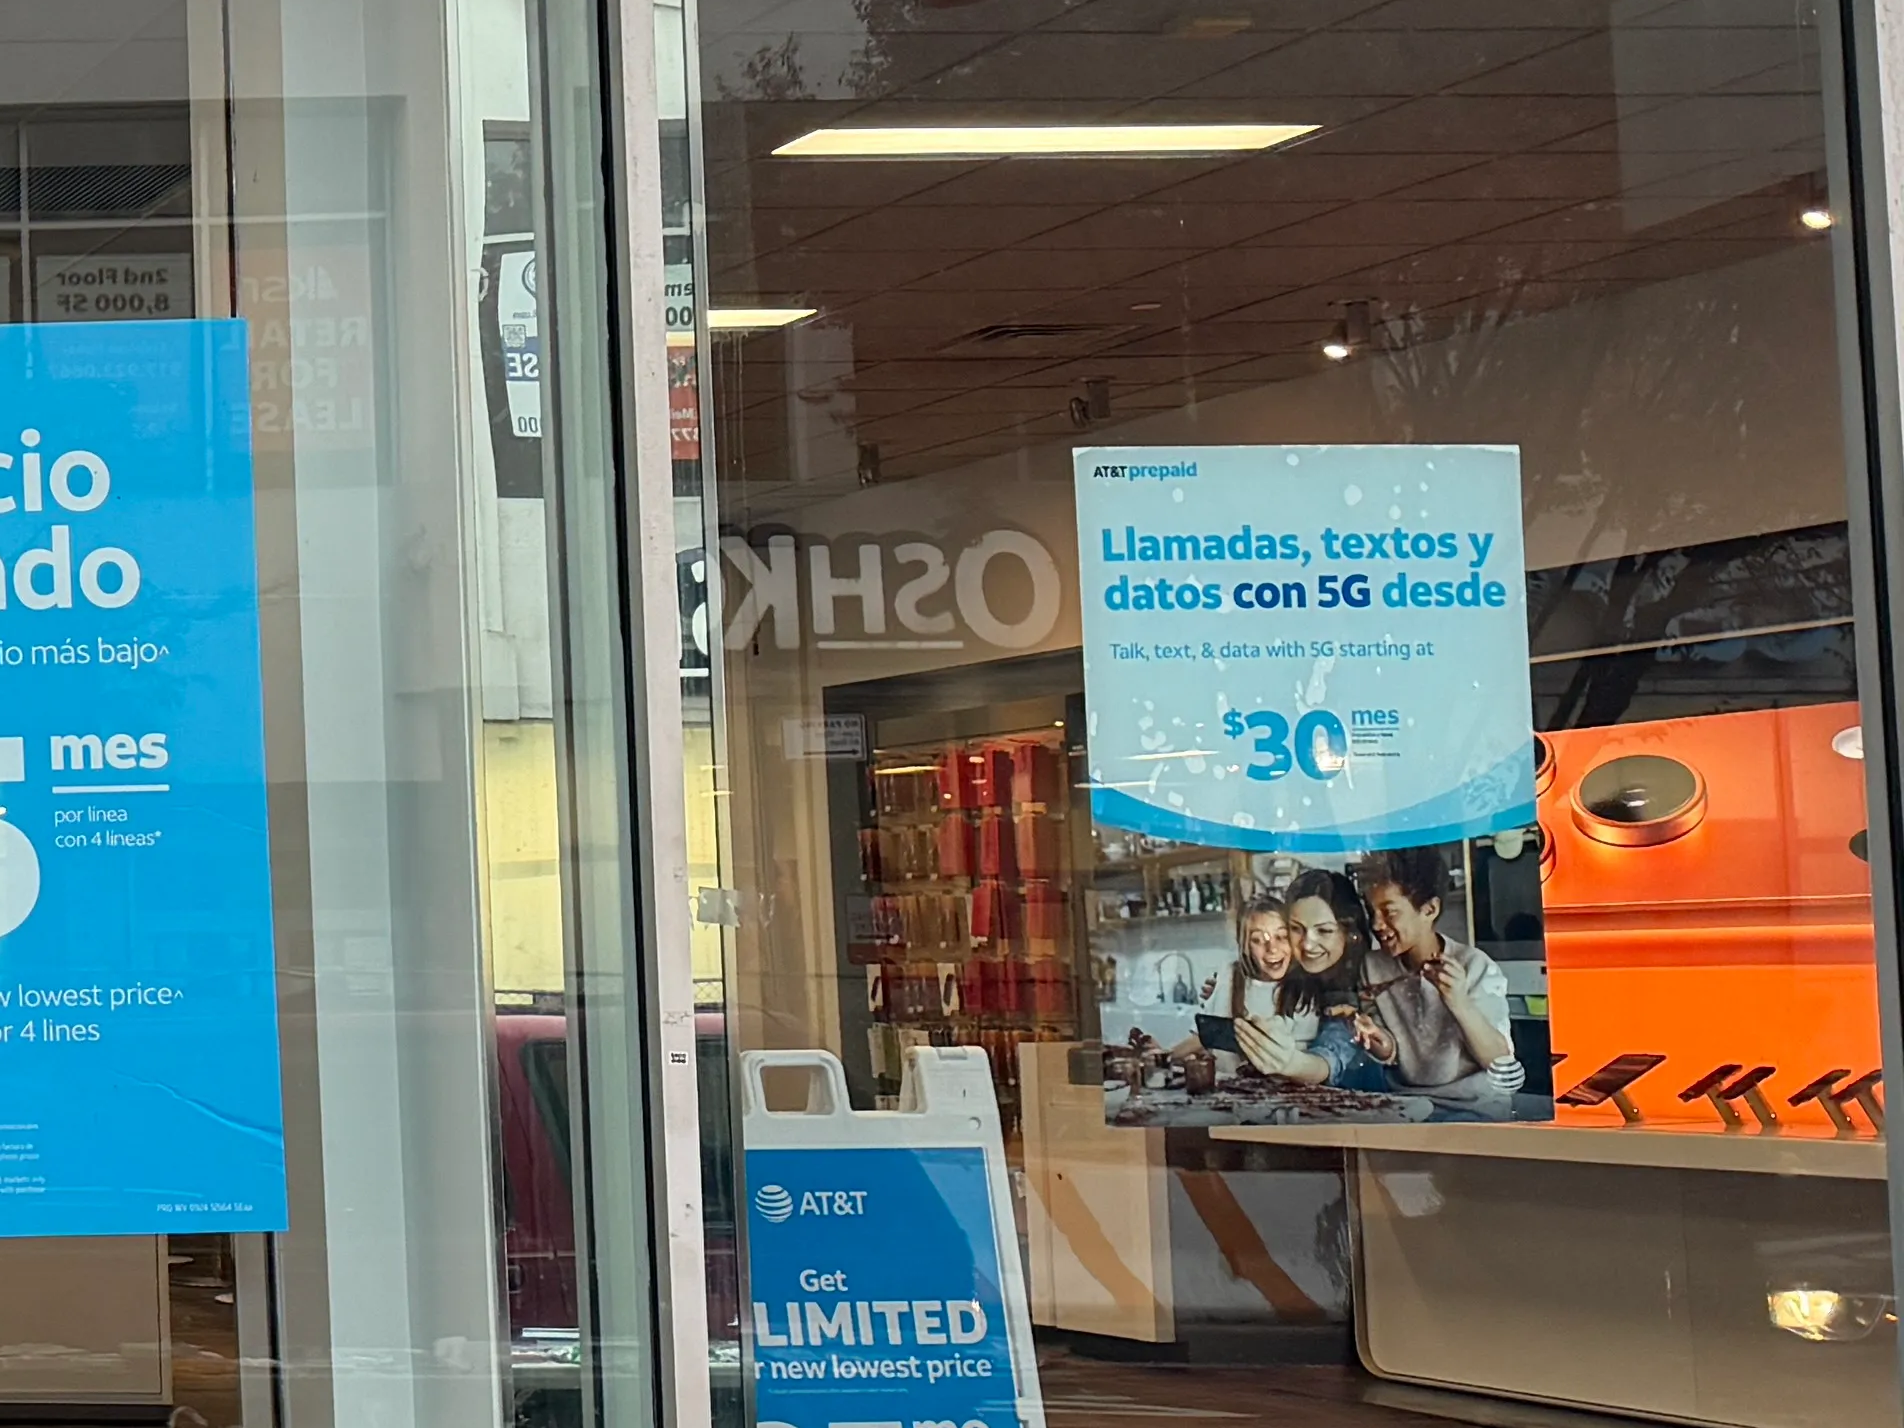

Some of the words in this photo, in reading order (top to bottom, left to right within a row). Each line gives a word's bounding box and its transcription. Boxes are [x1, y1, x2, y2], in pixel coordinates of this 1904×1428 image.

[1102, 525, 1311, 567] Llamadas,
[1321, 527, 1458, 559] textos
[1468, 531, 1494, 567] y
[1104, 574, 1222, 611] datos
[1233, 580, 1307, 609] con
[1318, 574, 1371, 608] 5G
[1383, 572, 1506, 608] desde
[30, 636, 89, 666] más
[1110, 643, 1150, 661] Talk,
[1155, 644, 1196, 661] text,
[1201, 643, 1215, 659] &
[1220, 642, 1260, 658] data
[1266, 641, 1305, 657] with
[1310, 642, 1334, 657] 5G
[1339, 640, 1411, 660] starting
[1416, 642, 1434, 657] at
[1351, 708, 1400, 725] mes
[50, 730, 169, 771] mes
[1223, 708, 1348, 781] $30
[53, 808, 82, 827] por
[86, 805, 128, 824] línea
[54, 833, 84, 848] con
[91, 831, 104, 847] 4
[18, 983, 101, 1009] lowest
[20, 1021, 36, 1043] 4
[43, 1016, 100, 1043] lines
[799, 1190, 867, 1216] AT&T
[799, 1269, 848, 1293] Get
[772, 1357, 826, 1379] new
[832, 1353, 922, 1380] lowest
[926, 1354, 992, 1384] price
